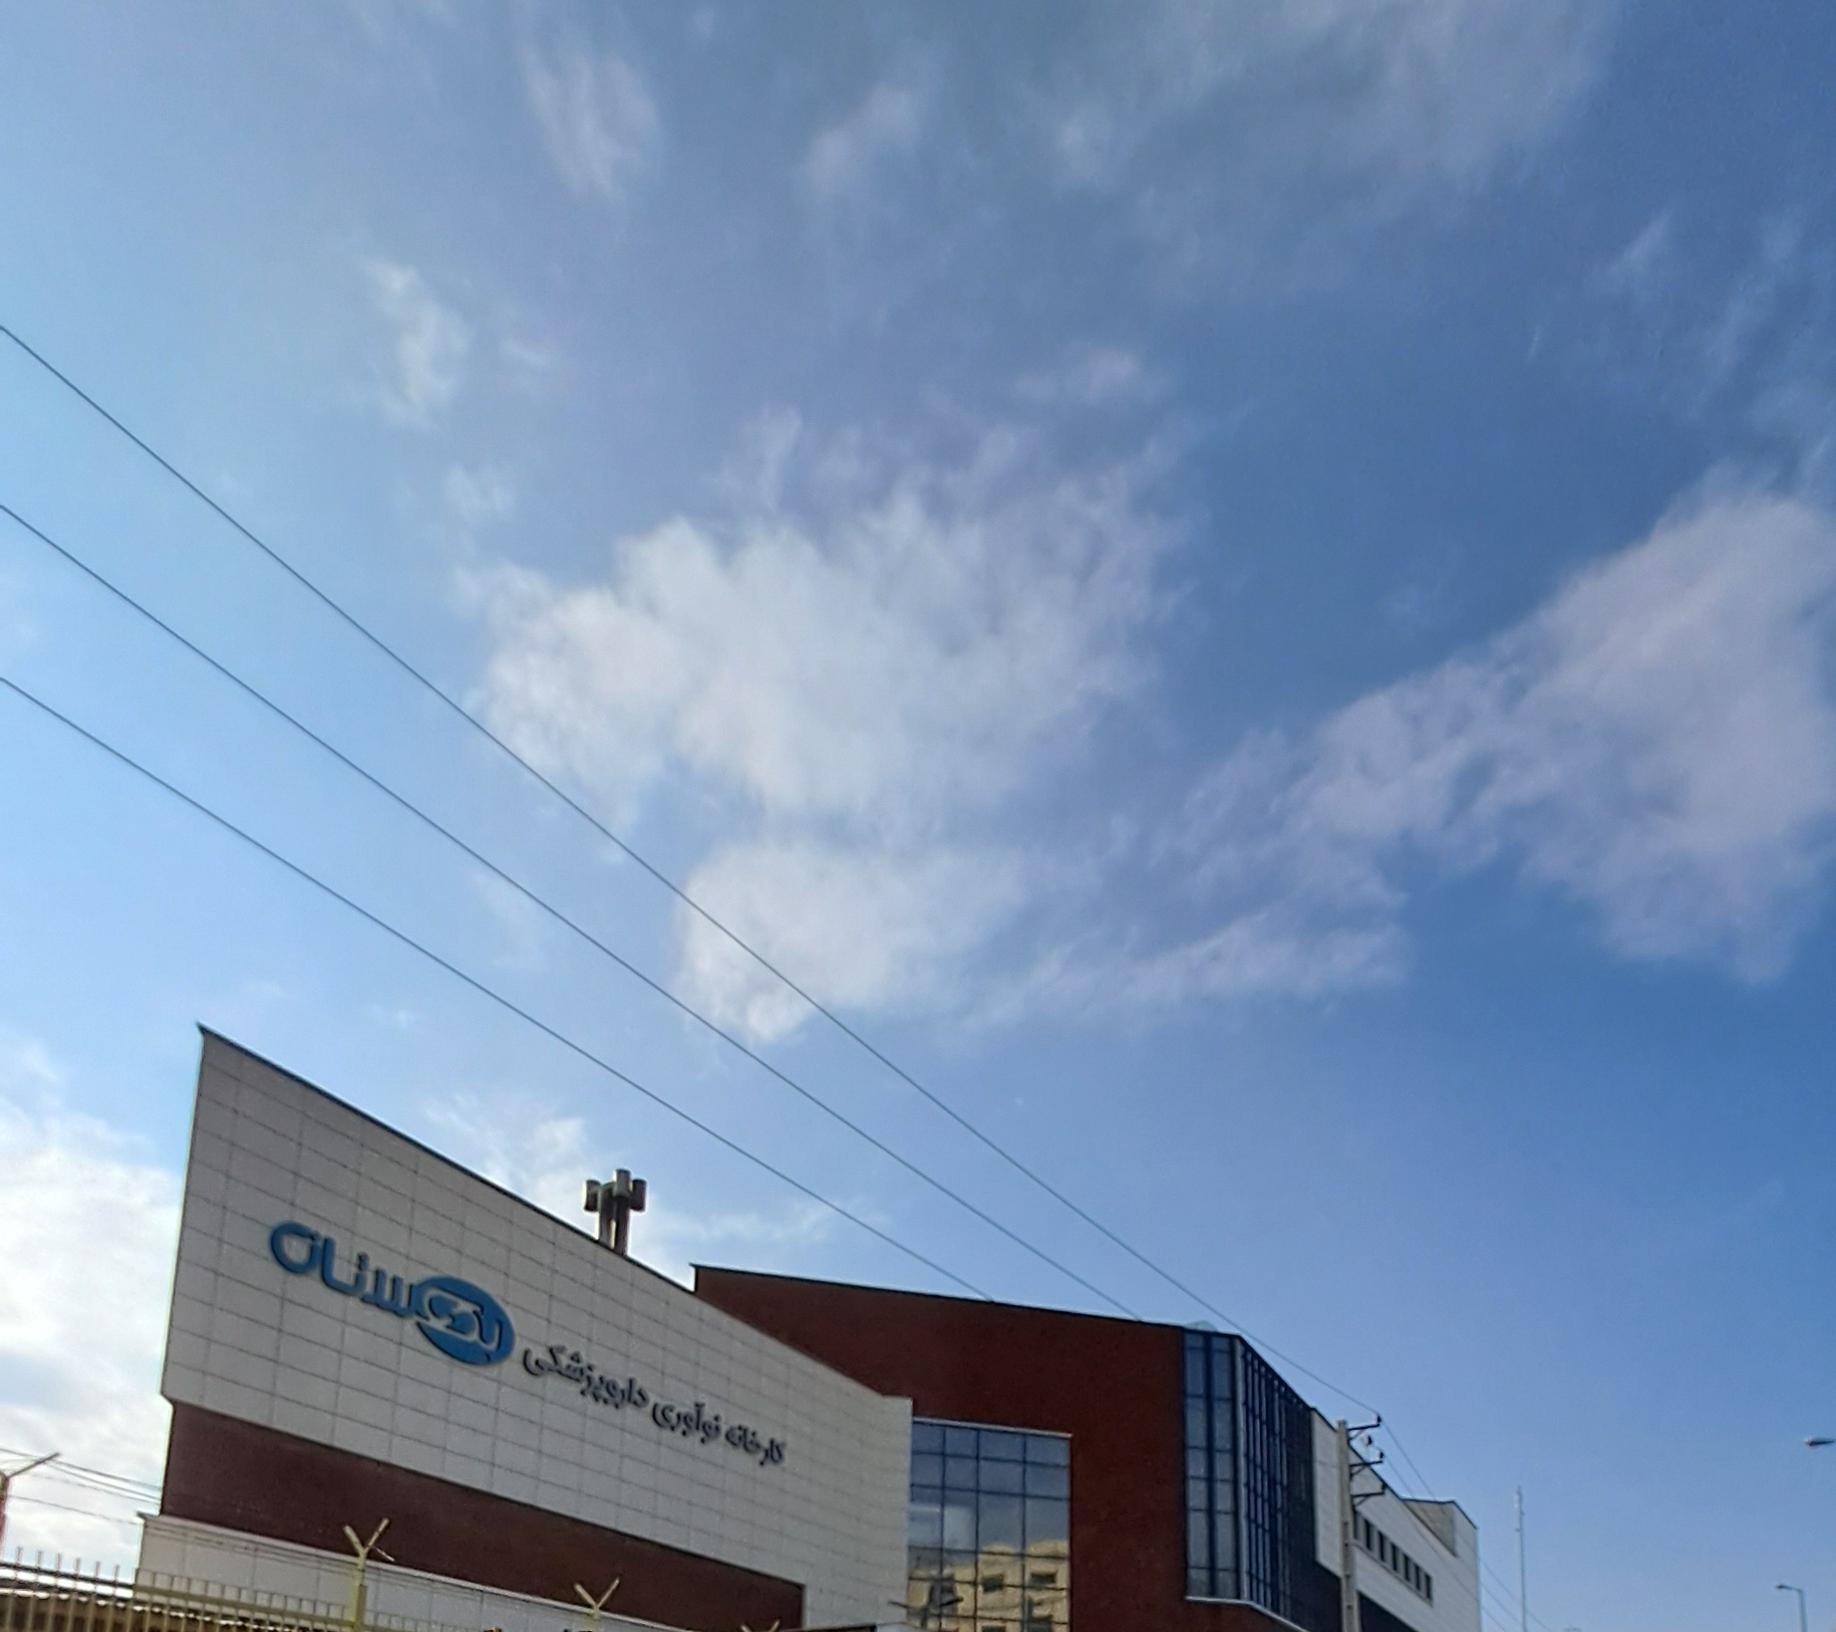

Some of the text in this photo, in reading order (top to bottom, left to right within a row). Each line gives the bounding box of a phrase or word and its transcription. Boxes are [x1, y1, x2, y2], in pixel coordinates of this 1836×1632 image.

[523, 1345, 787, 1468] کارخانه نوآوری داروپزشکی
